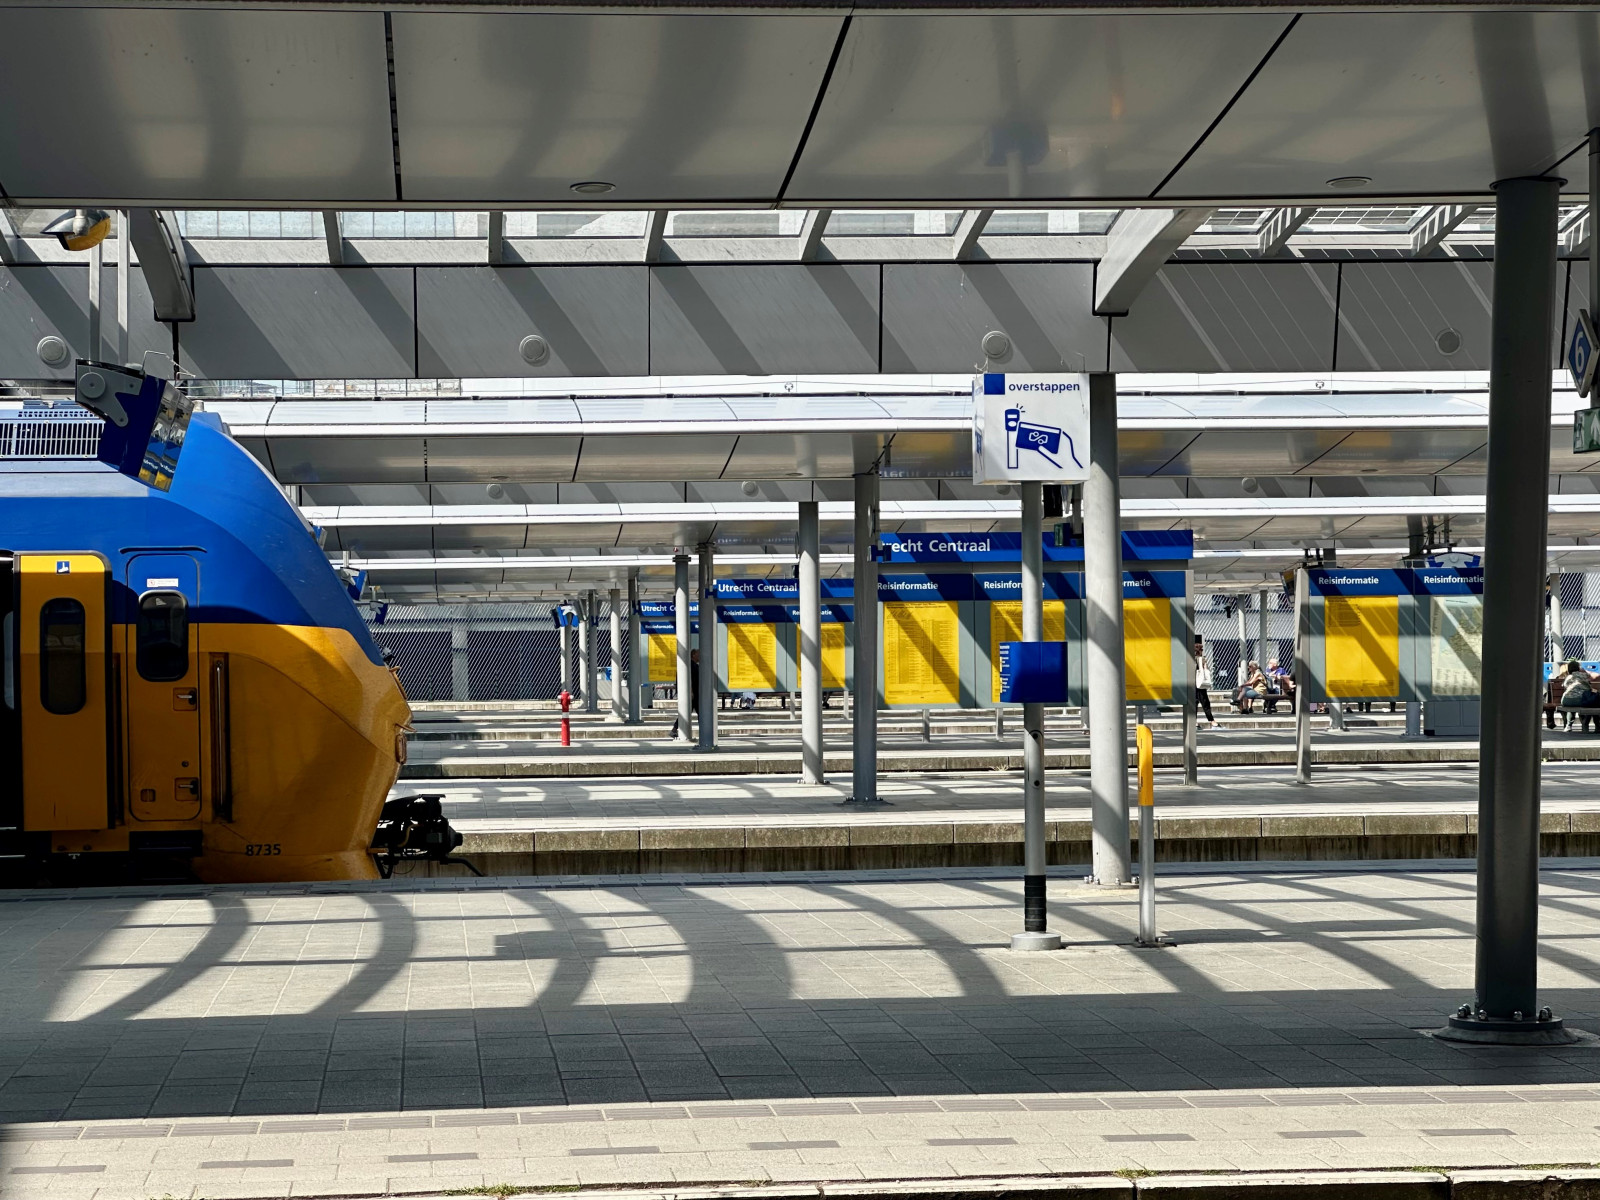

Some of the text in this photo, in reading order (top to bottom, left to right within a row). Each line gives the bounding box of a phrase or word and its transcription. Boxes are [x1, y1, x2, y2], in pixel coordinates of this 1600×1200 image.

[1575, 331, 1584, 373] 6
[1008, 382, 1080, 394] overstappen
[881, 538, 991, 552] echt Centraal
[1318, 576, 1379, 585] Reisinformatie
[1423, 574, 1485, 584] Reisinformatie
[718, 583, 797, 592] Utrecht Centraal
[877, 582, 939, 590] Reisinformatie
[245, 843, 281, 857] 8735
